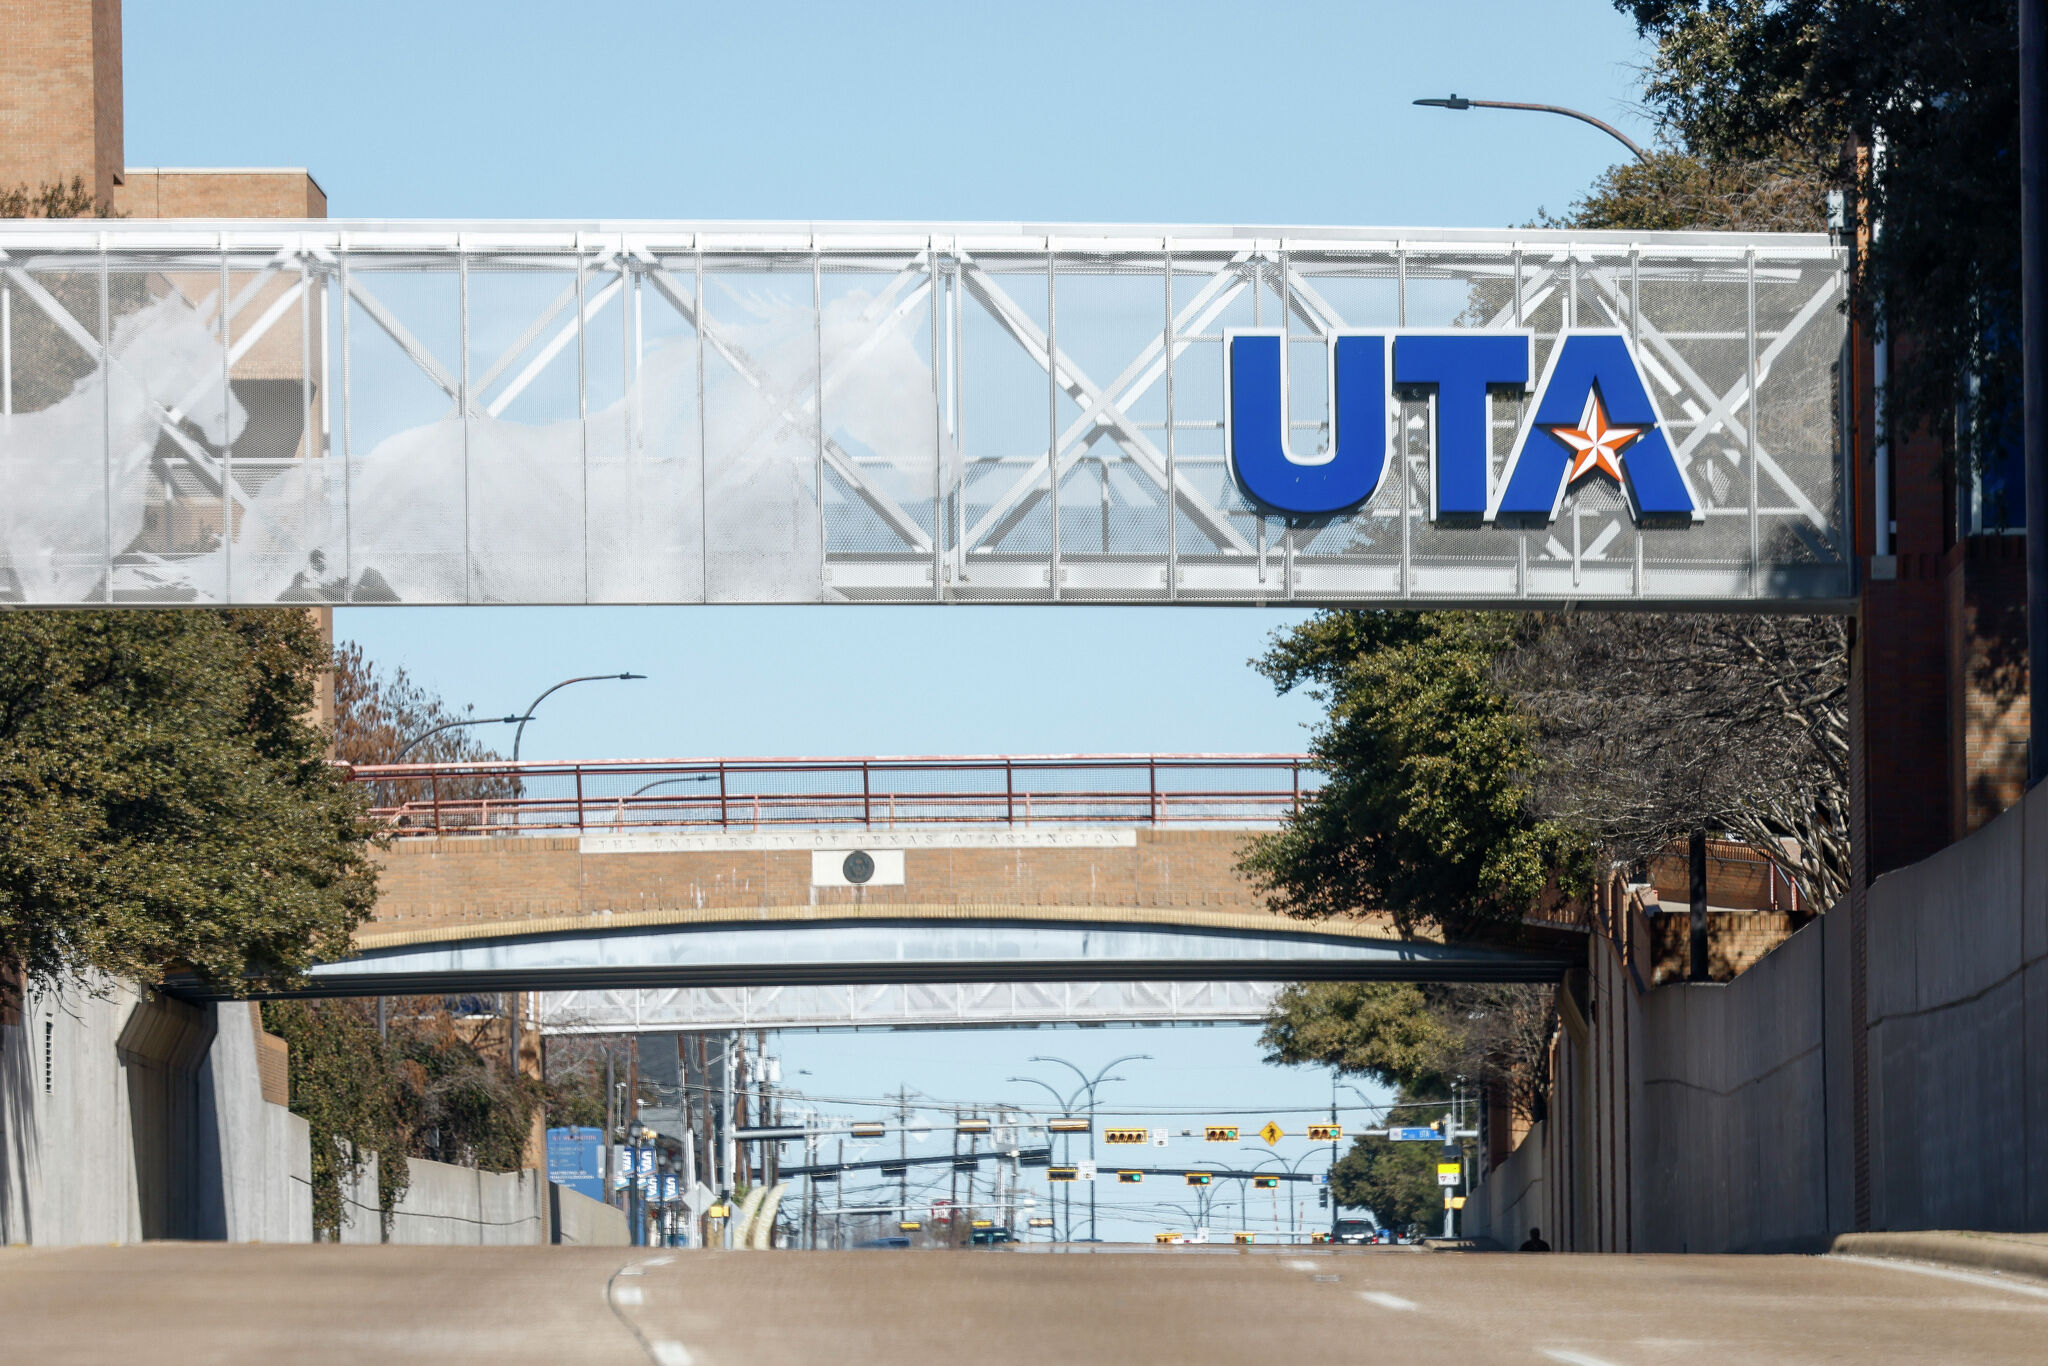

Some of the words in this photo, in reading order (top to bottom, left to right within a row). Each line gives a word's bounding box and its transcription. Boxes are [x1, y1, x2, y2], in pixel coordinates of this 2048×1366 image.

[1224, 328, 1705, 524] UTA
[598, 839, 637, 849] THE
[655, 836, 798, 849] UNIVERSITY
[815, 835, 840, 846] OF
[857, 835, 934, 846] TEXAS
[990, 834, 1121, 844] ARLINGTON
